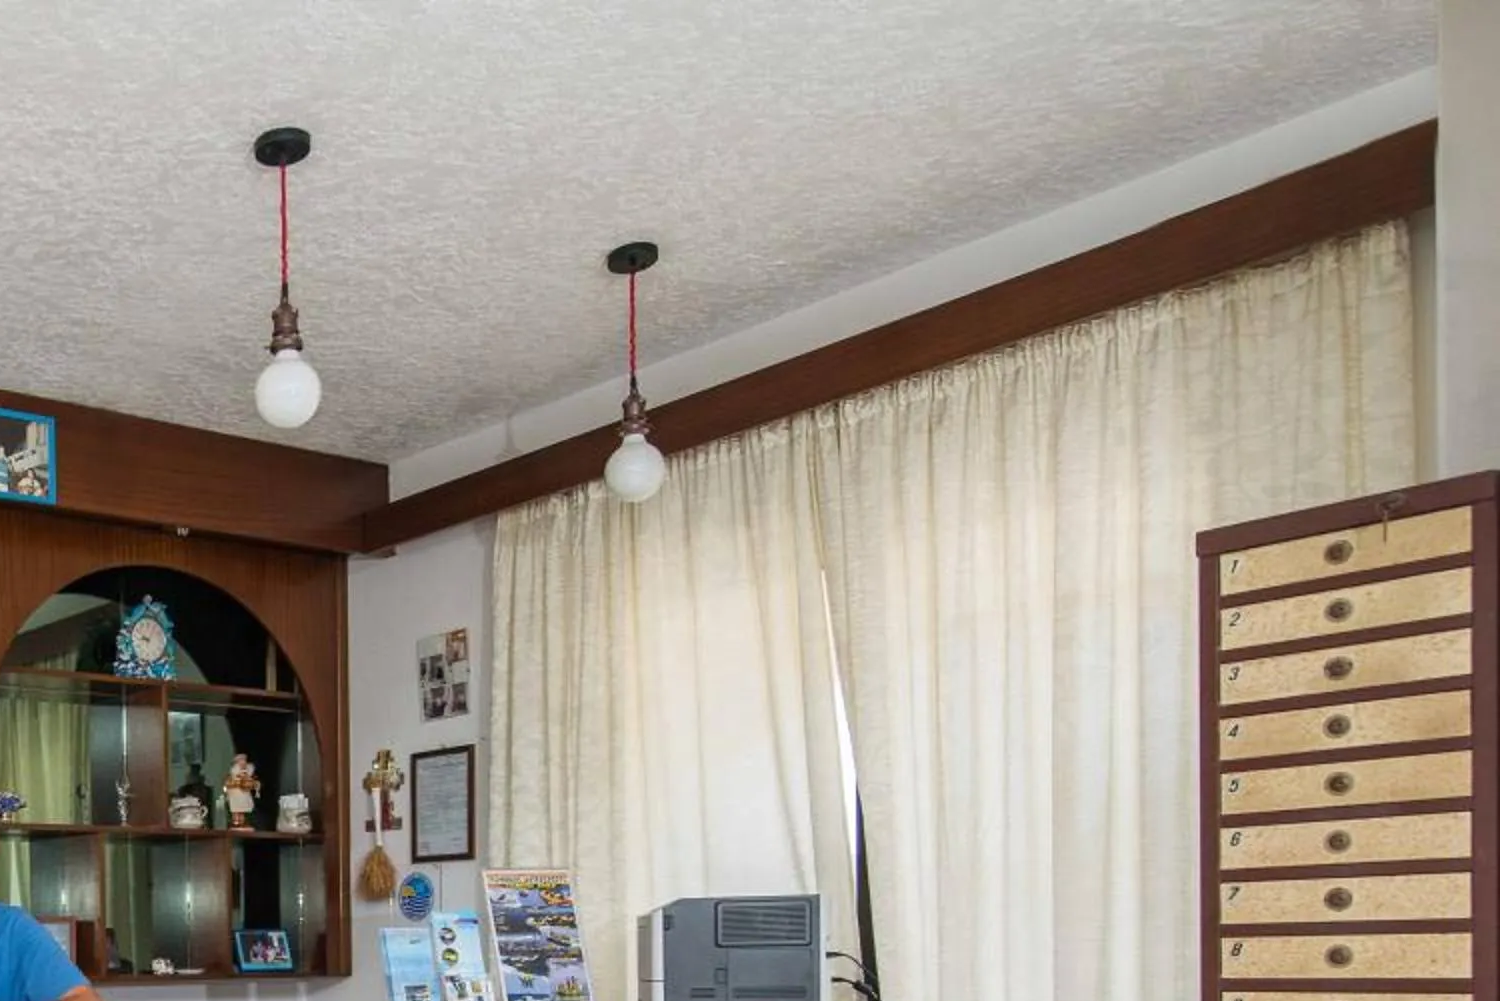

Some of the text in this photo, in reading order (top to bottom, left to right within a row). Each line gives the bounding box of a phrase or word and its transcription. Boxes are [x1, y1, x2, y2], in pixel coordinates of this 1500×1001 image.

[1230, 559, 1239, 574] 1
[1228, 611, 1242, 628] 2
[1227, 666, 1241, 682] 3
[1227, 724, 1240, 738] 4
[1227, 778, 1240, 793] 5
[1229, 831, 1243, 847] 6
[1227, 886, 1241, 901] 7
[1230, 942, 1244, 957] 8
